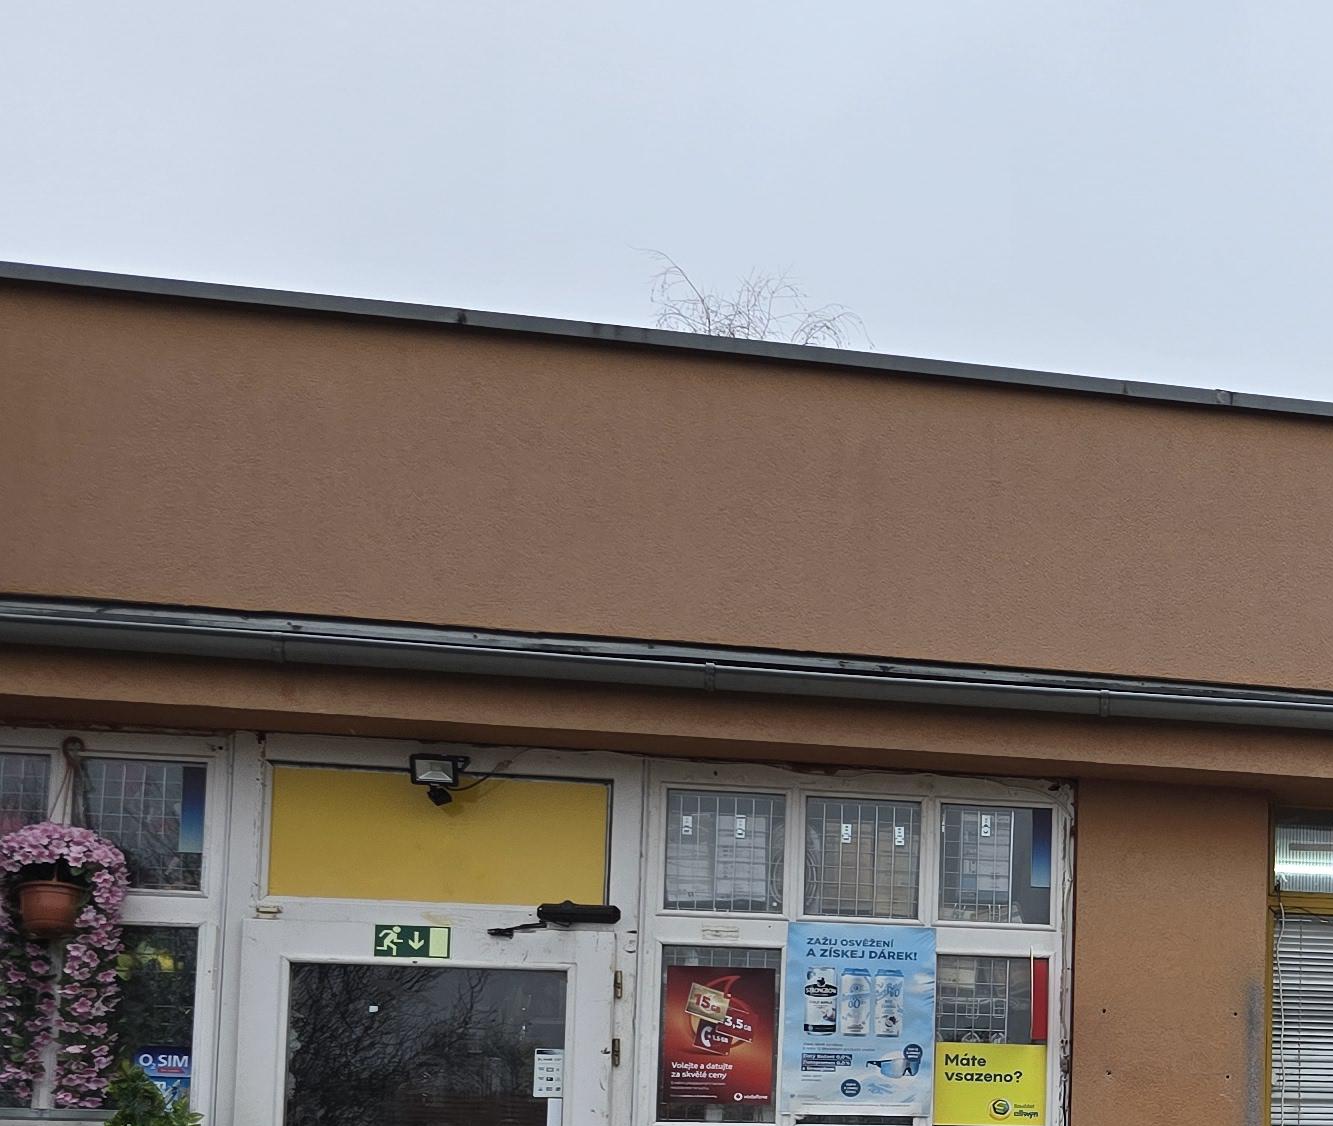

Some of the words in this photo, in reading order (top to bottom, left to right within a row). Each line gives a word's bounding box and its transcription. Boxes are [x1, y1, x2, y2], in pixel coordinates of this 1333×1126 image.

[807, 937, 838, 946] ZAŽIJ
[840, 938, 894, 948] OSVĚŽENÍ
[806, 949, 816, 957] A
[820, 947, 865, 959] ZÍSKEJ
[868, 948, 918, 960] DÁREK!
[157, 1055, 189, 1067] SIM
[945, 1053, 987, 1067] Máte
[945, 1070, 1023, 1083] vsazeno?
